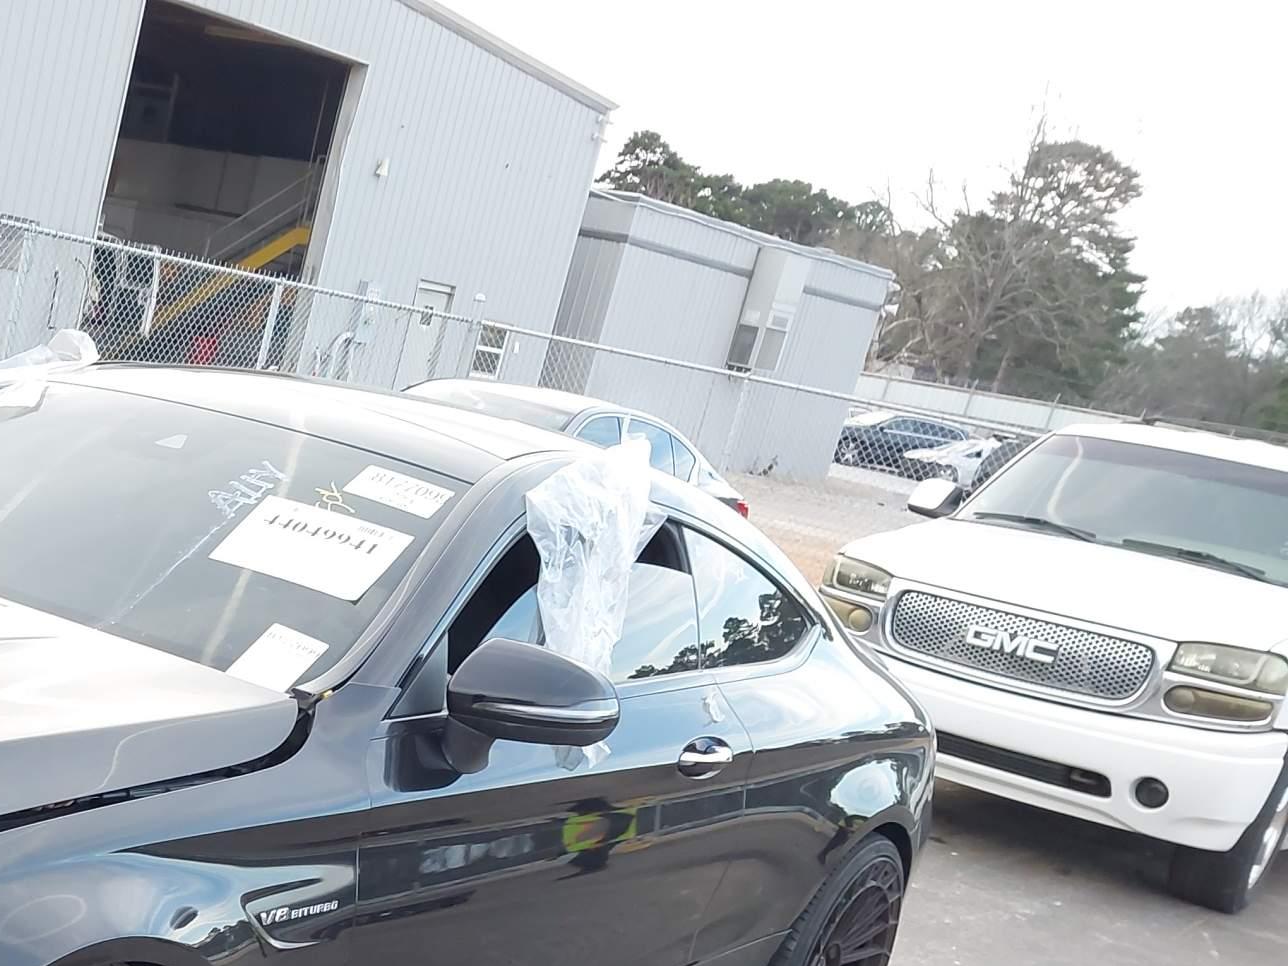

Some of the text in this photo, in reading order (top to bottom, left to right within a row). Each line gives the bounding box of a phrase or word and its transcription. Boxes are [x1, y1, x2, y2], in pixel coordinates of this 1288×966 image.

[264, 514, 379, 555] 44049941
[966, 625, 1061, 664] GMC
[259, 900, 339, 926] V8 BITURBO
